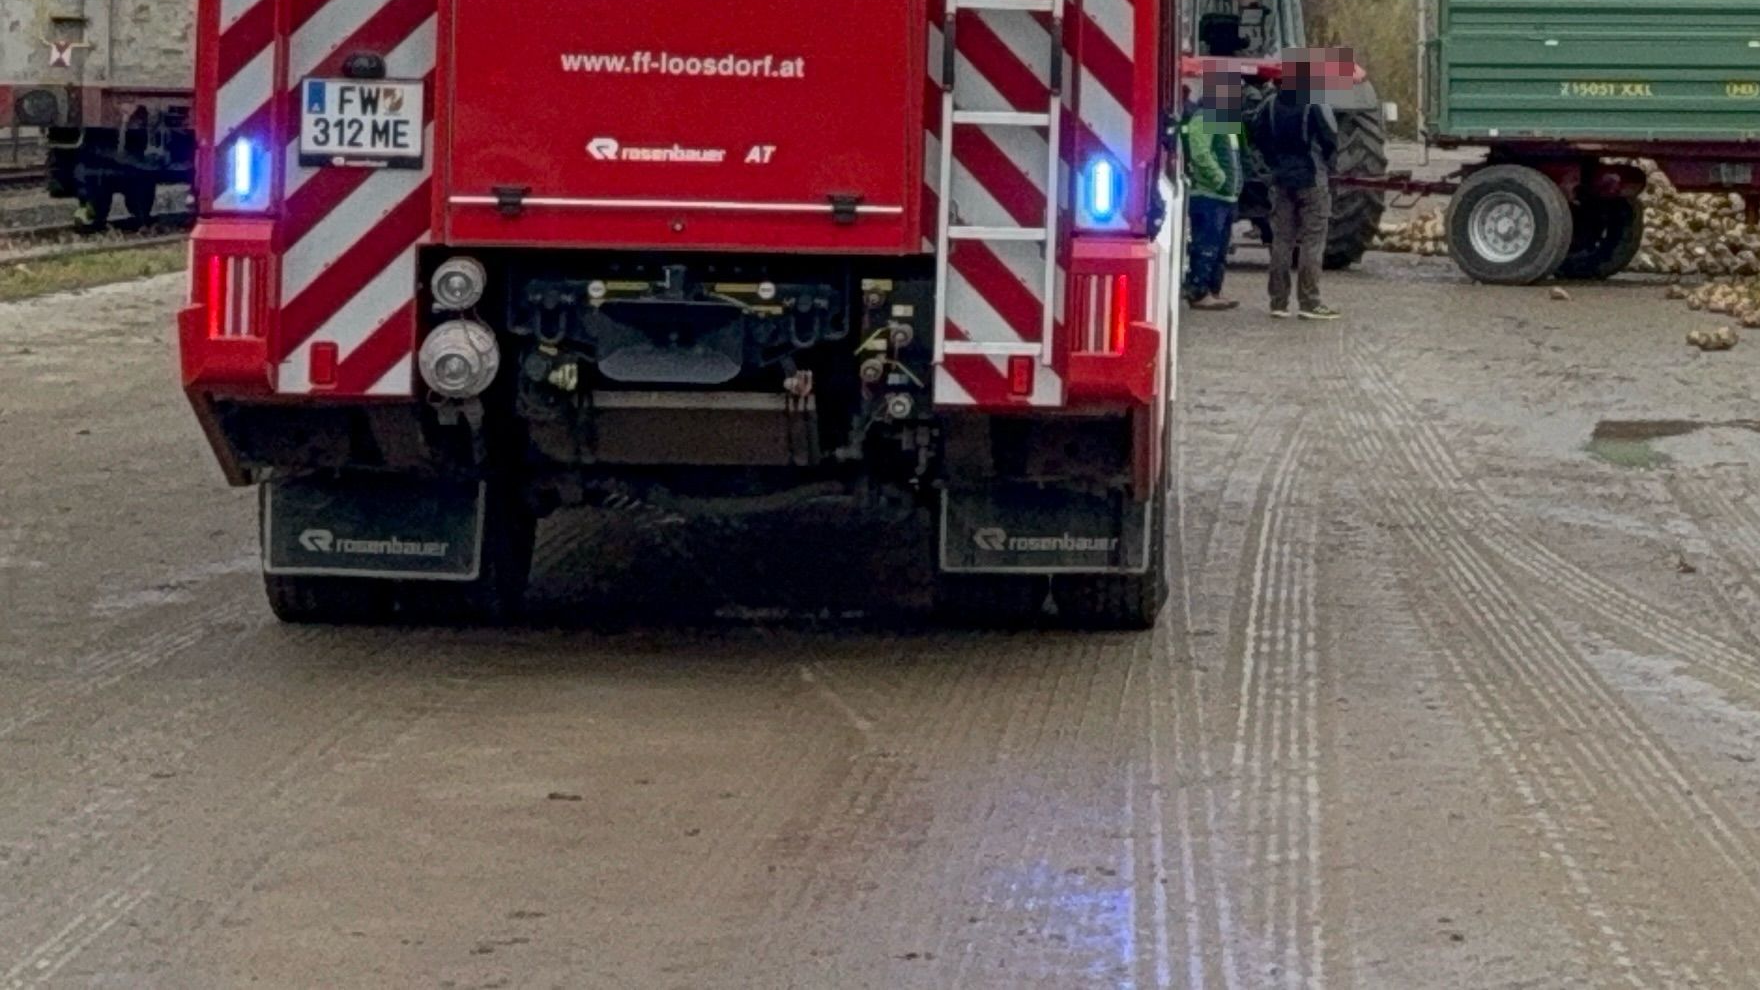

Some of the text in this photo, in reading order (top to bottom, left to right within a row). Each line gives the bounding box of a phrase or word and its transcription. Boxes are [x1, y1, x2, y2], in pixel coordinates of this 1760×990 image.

[561, 52, 805, 78] www.ff-loosdorf.at
[338, 85, 381, 115] FW
[312, 117, 410, 148] 312 ME
[621, 143, 726, 162] rosenbauer
[744, 146, 777, 163] AT
[336, 535, 449, 557] rosenbauer
[1008, 532, 1119, 551] rosenbauer
